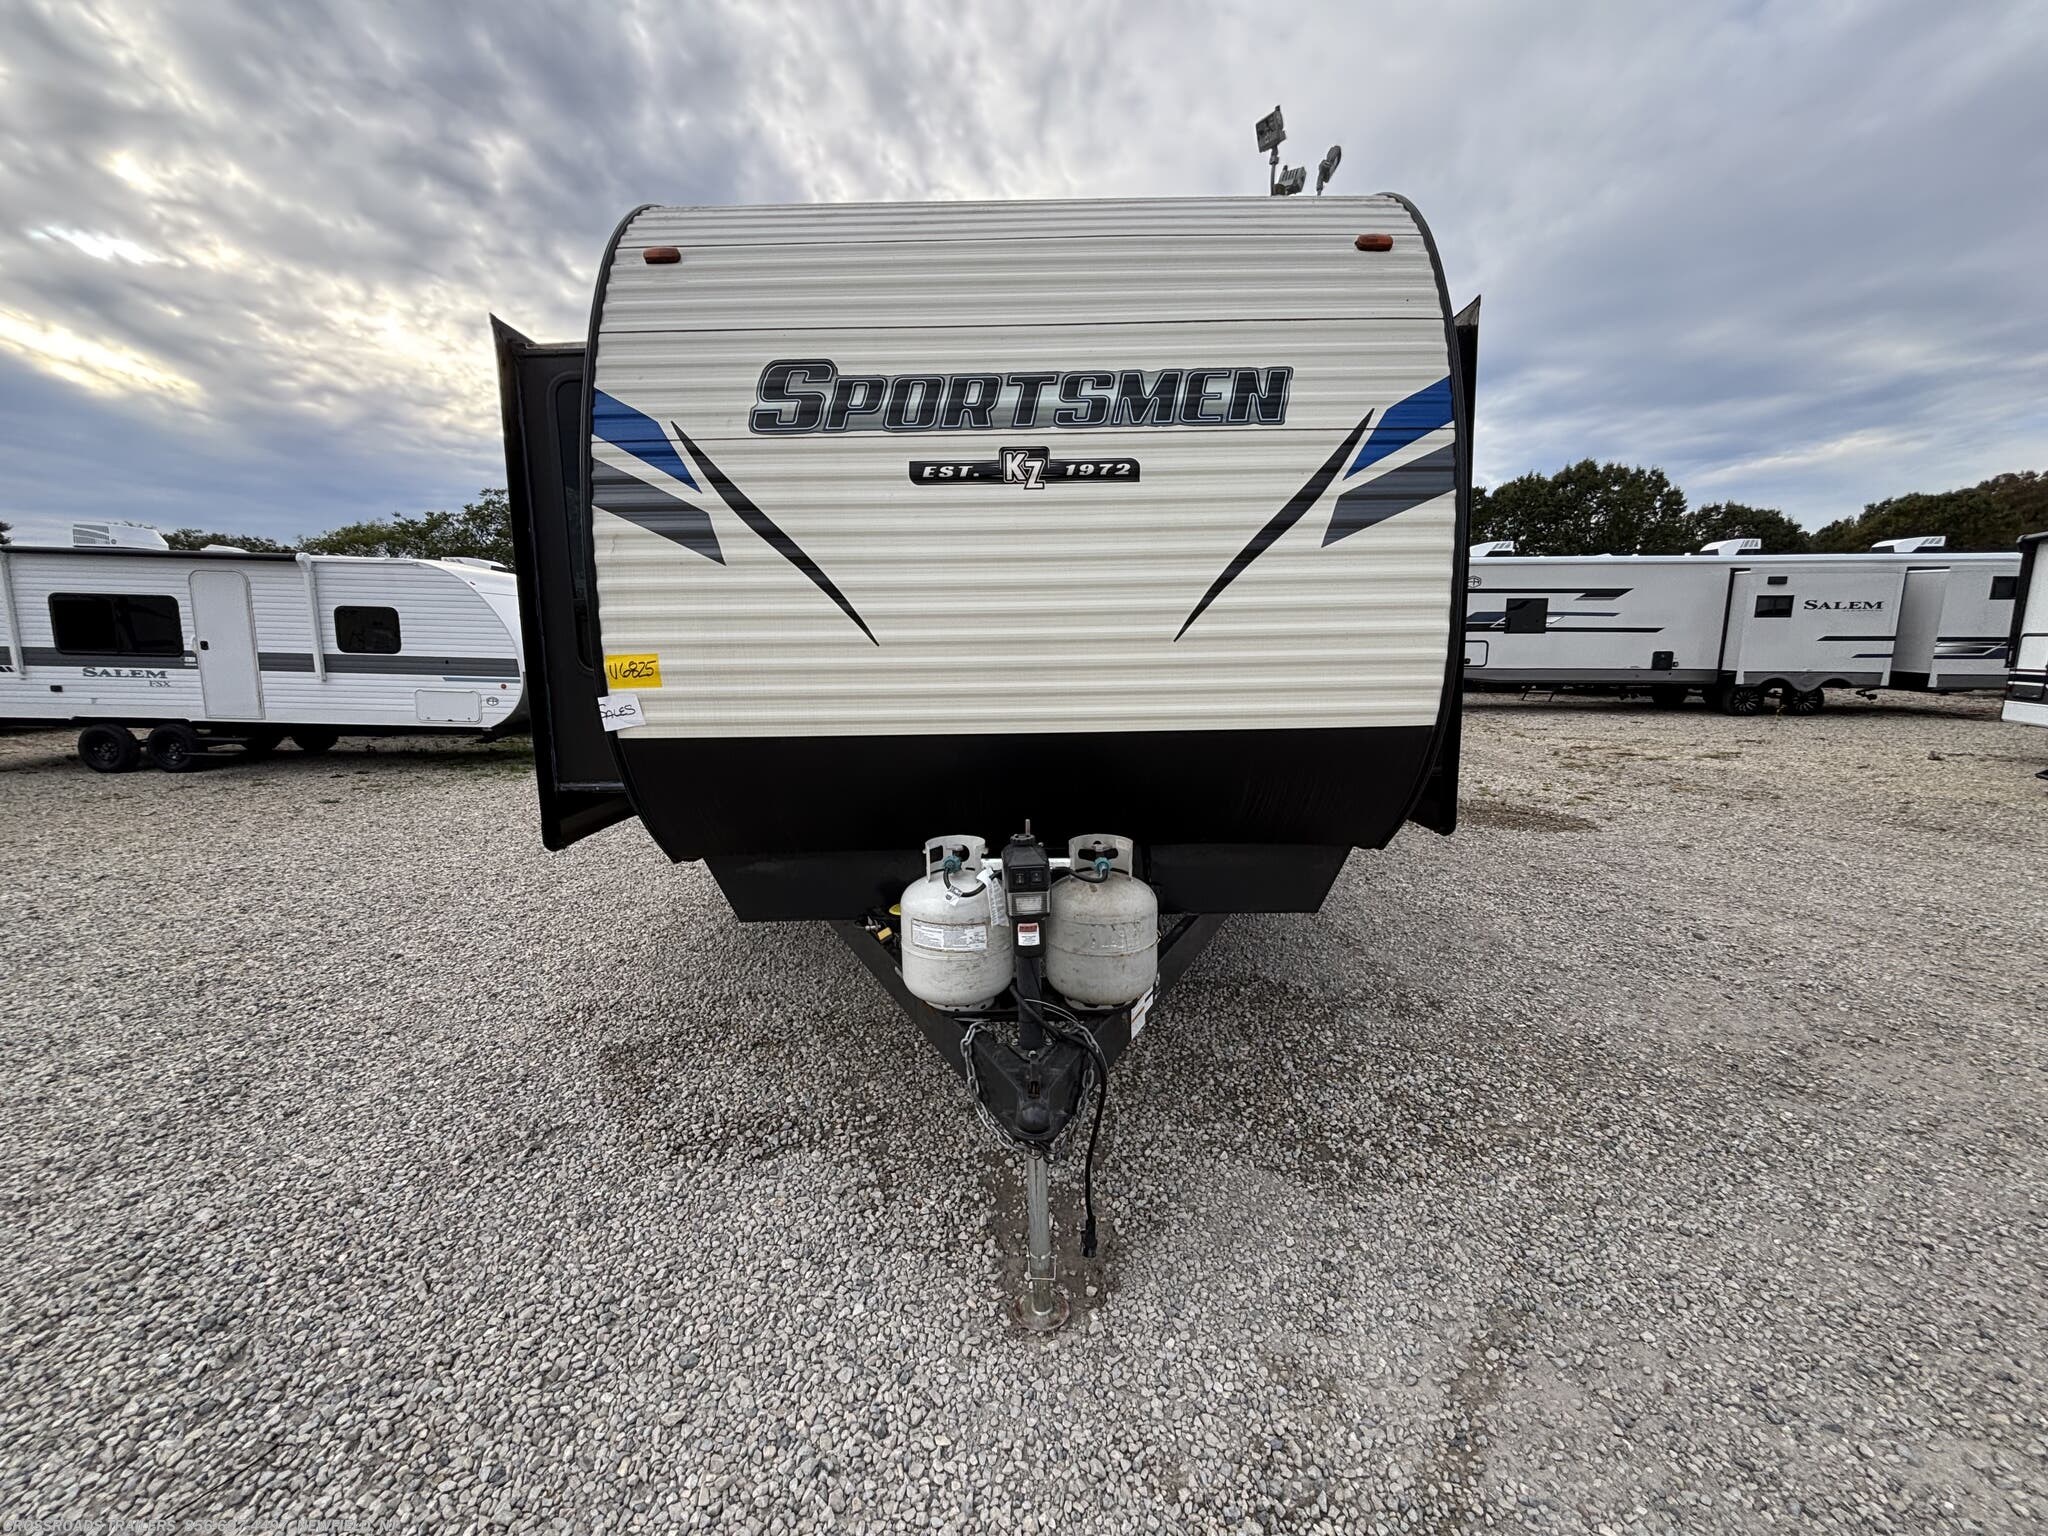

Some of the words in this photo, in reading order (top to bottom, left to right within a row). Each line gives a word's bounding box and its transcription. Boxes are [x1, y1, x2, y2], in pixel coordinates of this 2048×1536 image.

[750, 359, 1293, 434] SPORTSMEN
[922, 465, 980, 478] EST.
[1003, 451, 1045, 489] KZ
[1065, 463, 1131, 476] 1972
[1803, 599, 1884, 610] SALEM
[82, 667, 168, 679] SALEM
